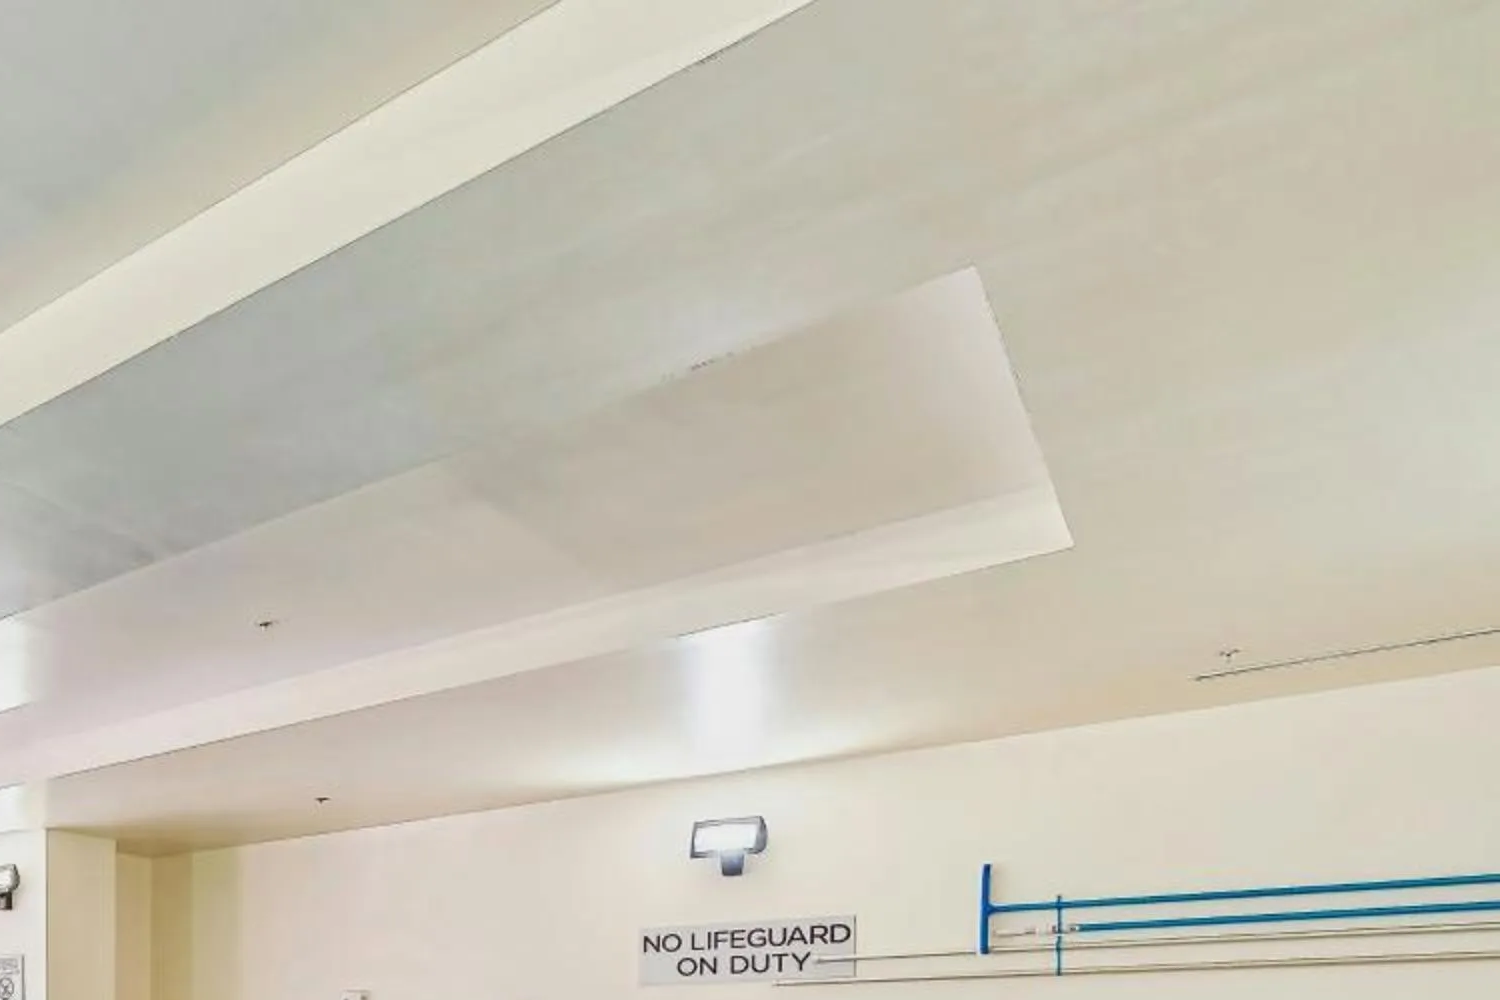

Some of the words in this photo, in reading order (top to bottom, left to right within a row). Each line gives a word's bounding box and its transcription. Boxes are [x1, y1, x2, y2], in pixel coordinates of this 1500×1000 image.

[643, 933, 683, 953] NO
[691, 923, 851, 951] LIFEGUARD
[677, 957, 717, 977] ON
[730, 952, 811, 975] DUTY
